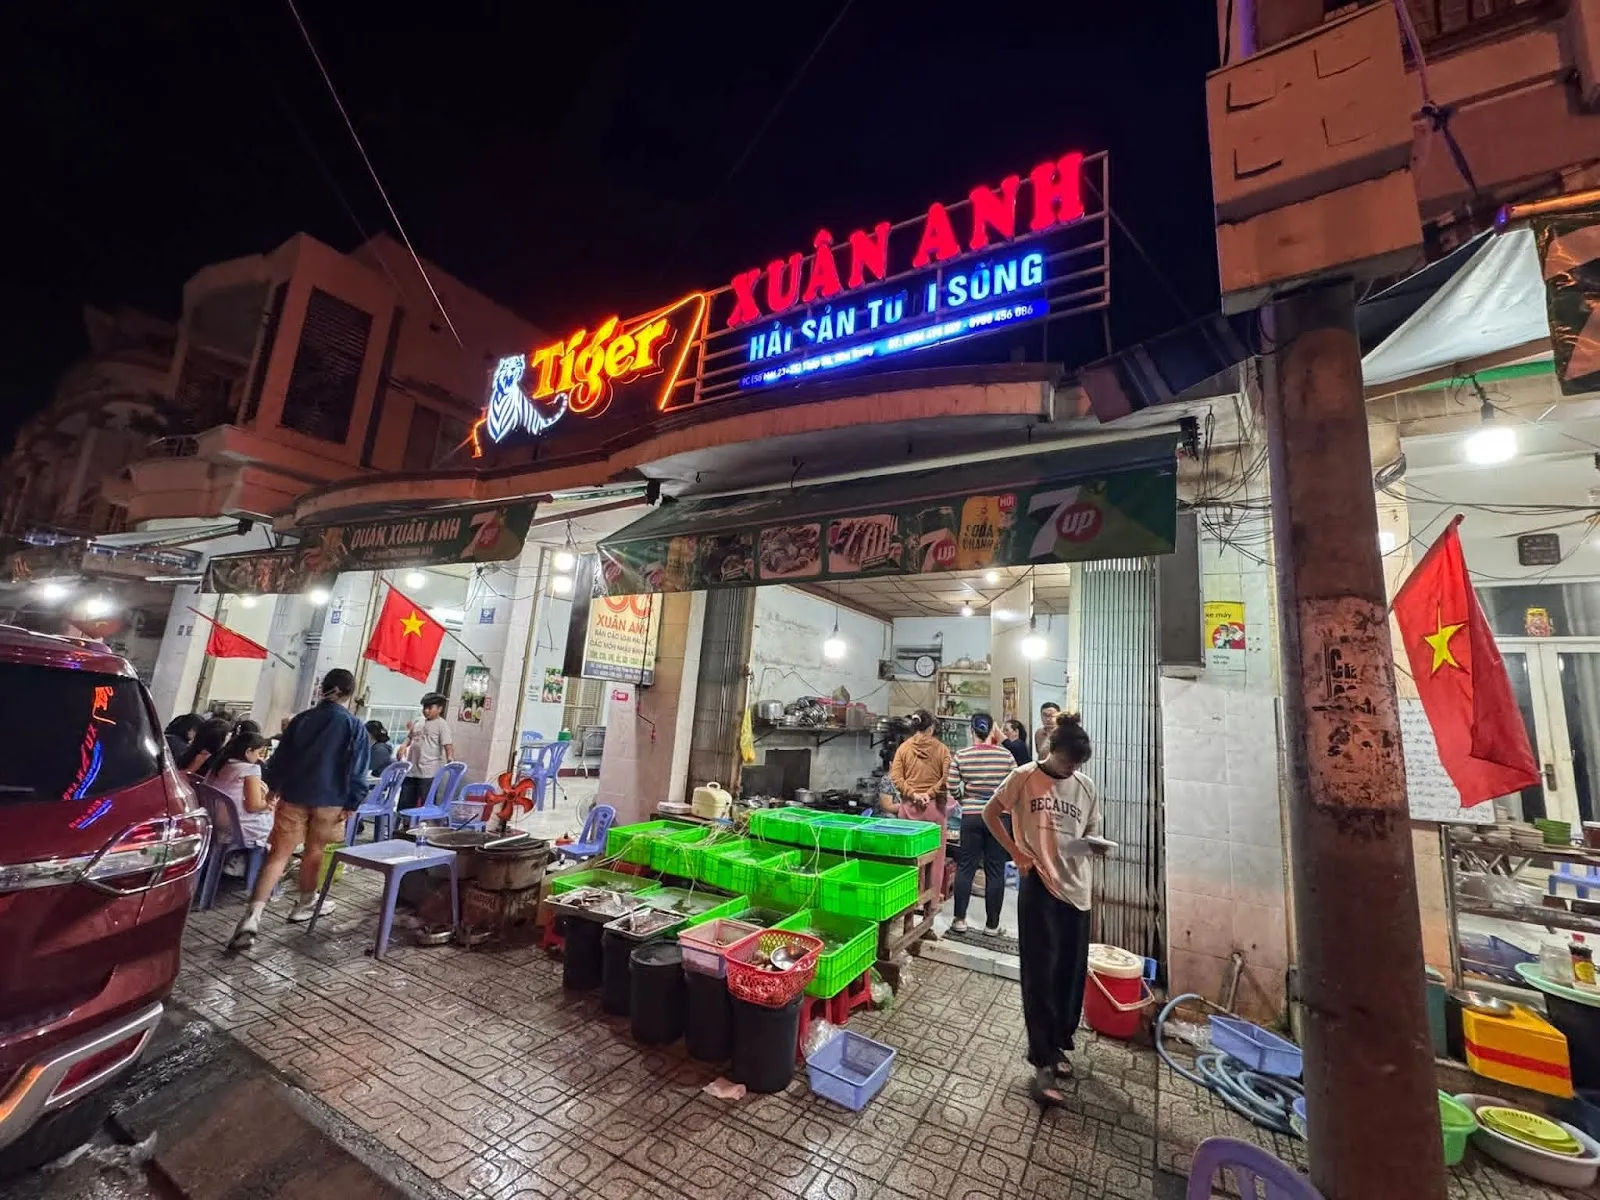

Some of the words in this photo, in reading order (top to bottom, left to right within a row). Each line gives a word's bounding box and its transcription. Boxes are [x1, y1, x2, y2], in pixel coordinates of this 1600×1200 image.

[727, 221, 891, 329] XUÂN
[912, 152, 1086, 268] ANH
[750, 320, 793, 361] HẢI
[801, 304, 856, 344] SẢN
[867, 282, 938, 329] TƯI
[531, 315, 668, 413] Tiger
[388, 517, 428, 546] XUÂN
[428, 516, 462, 542] ANH
[596, 614, 627, 632] XUÂN
[1031, 797, 1082, 824] BECAUSE
